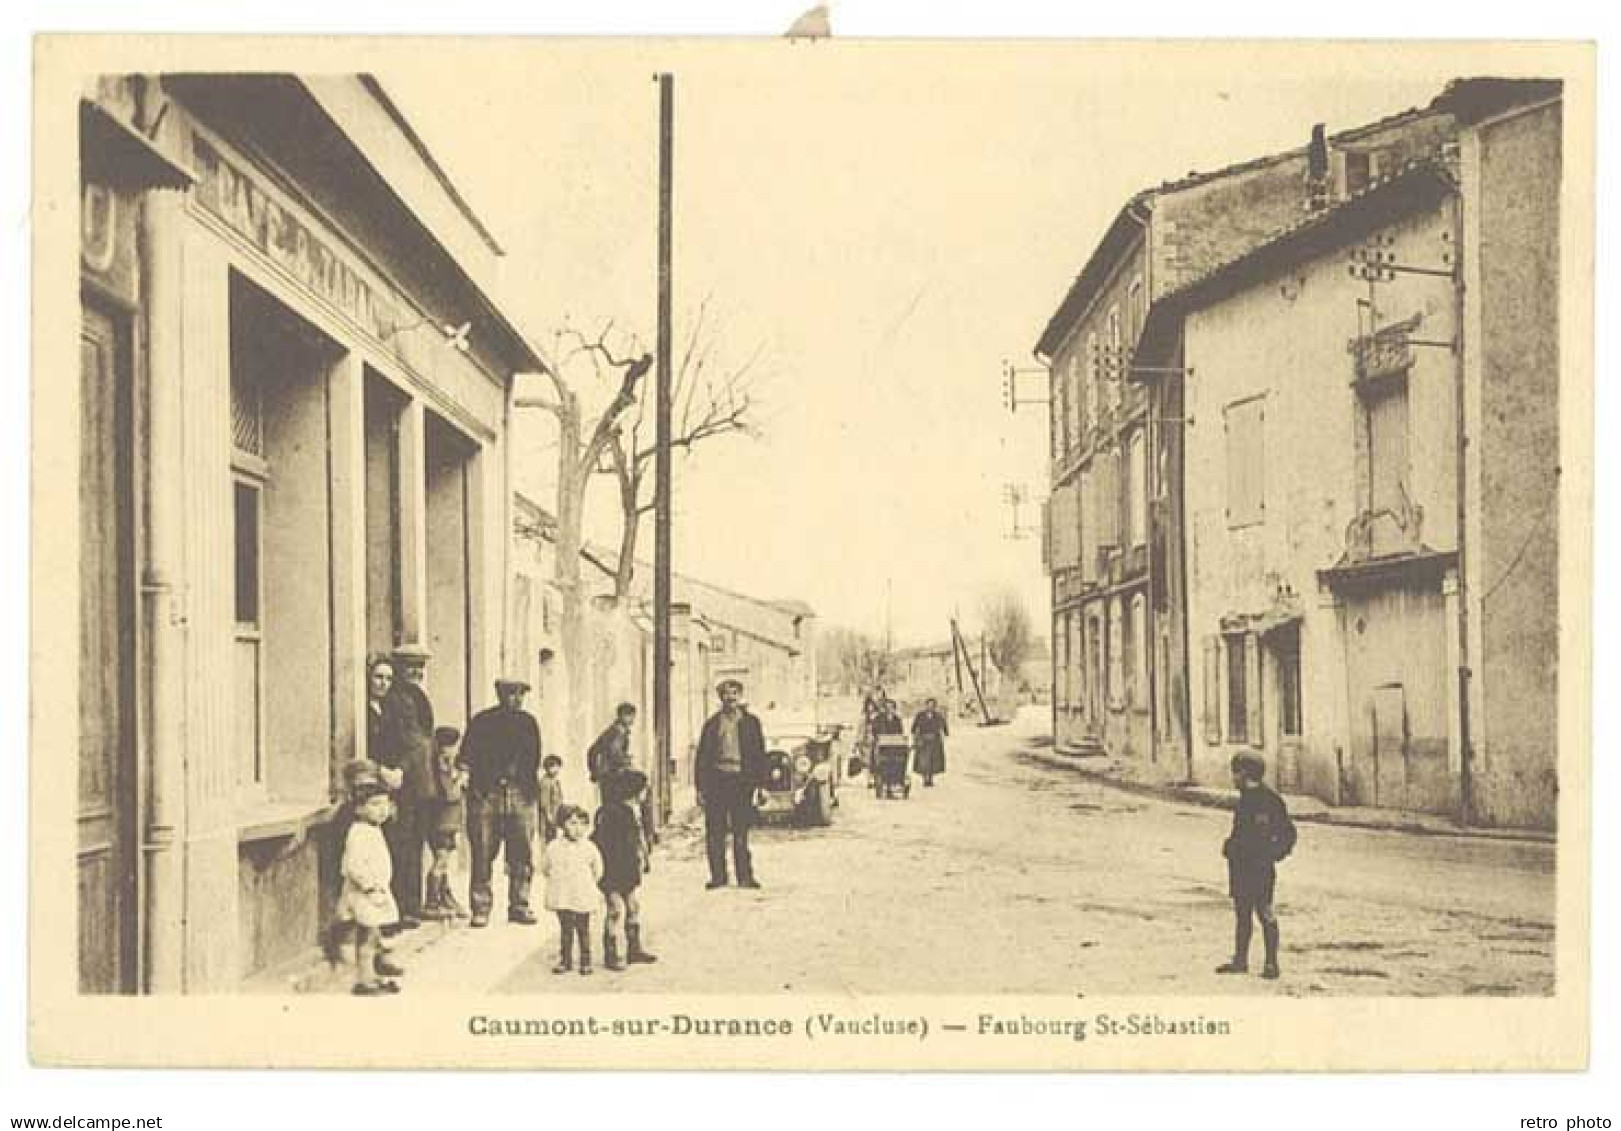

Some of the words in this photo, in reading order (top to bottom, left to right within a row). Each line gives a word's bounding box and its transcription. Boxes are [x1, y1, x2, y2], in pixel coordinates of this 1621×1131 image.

[468, 1014, 793, 1036] Caumont-sur-Durance
[804, 1013, 929, 1040] (Vaucluse)
[977, 1014, 1087, 1042] Faubourg
[1094, 1013, 1232, 1035] St-Sébastien
